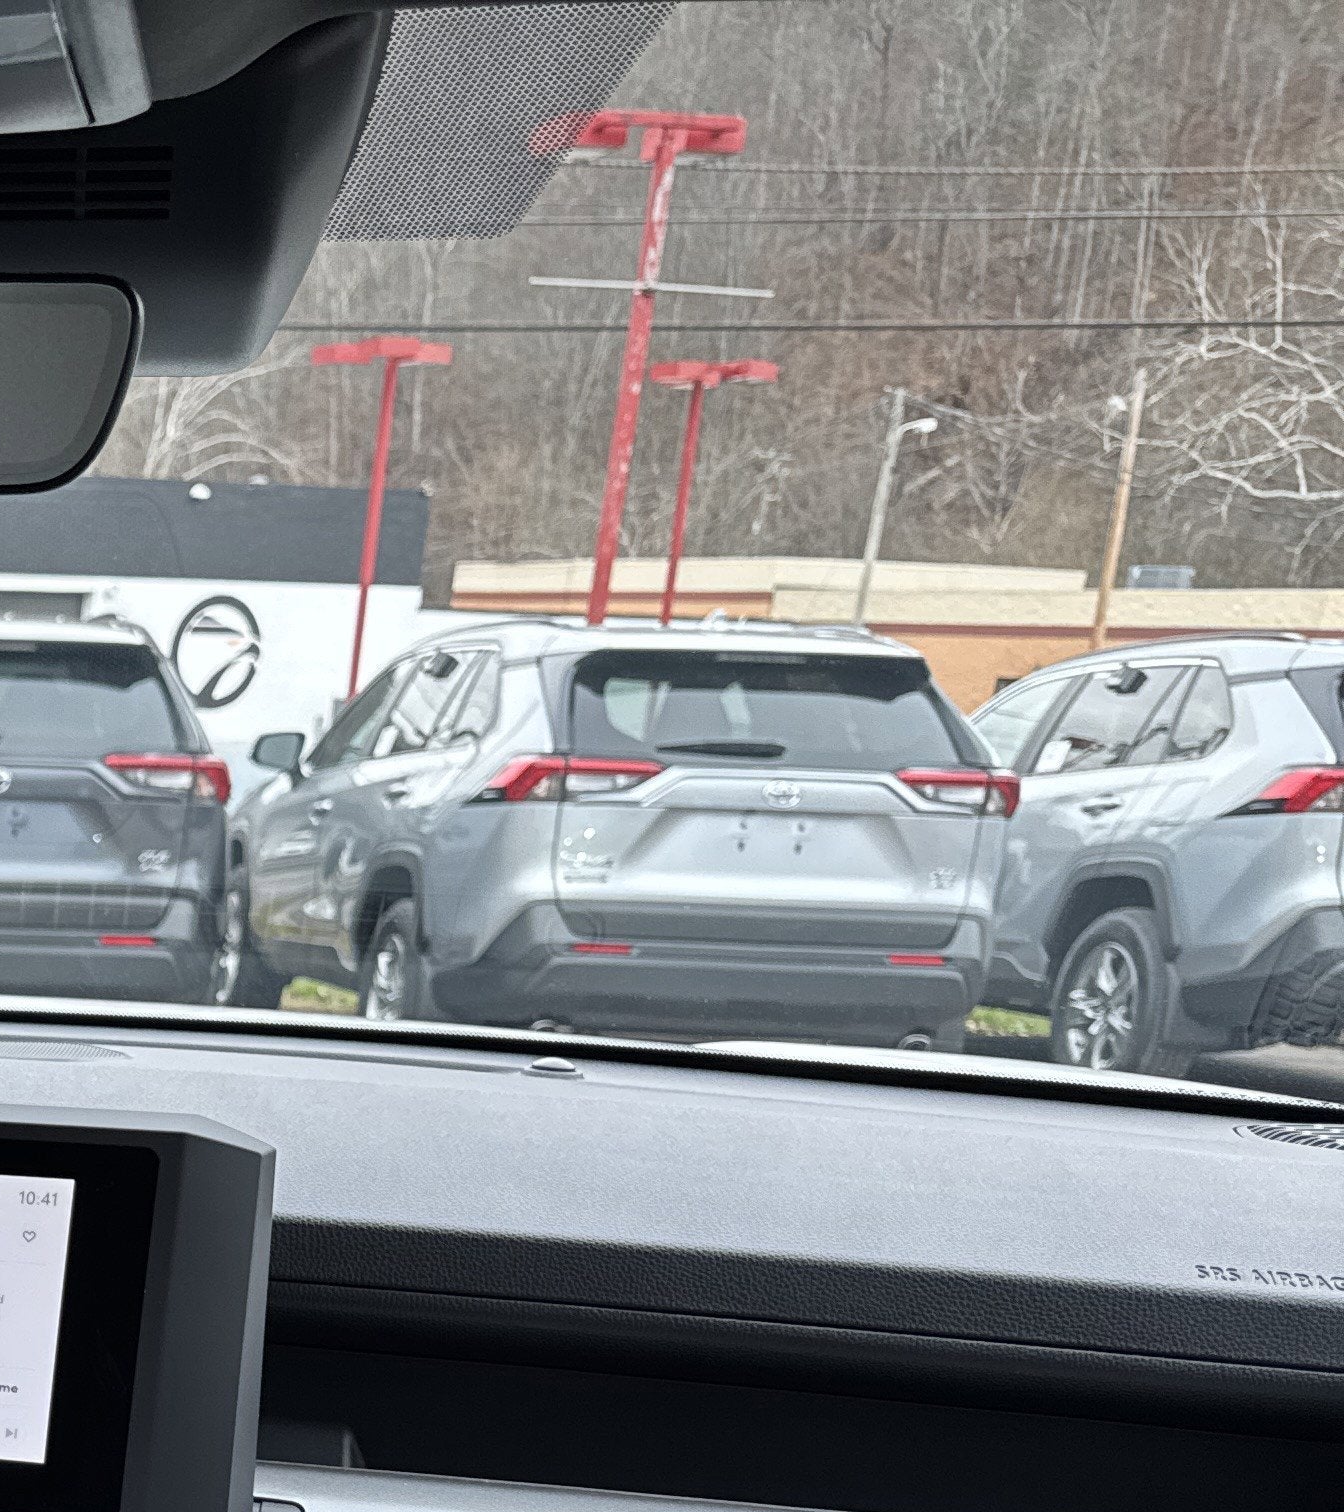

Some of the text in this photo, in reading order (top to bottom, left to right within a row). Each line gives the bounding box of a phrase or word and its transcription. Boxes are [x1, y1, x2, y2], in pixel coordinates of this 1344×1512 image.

[18, 1190, 59, 1207] 10:41
[1194, 1264, 1242, 1283] SRS
[0, 1383, 19, 1394] me
